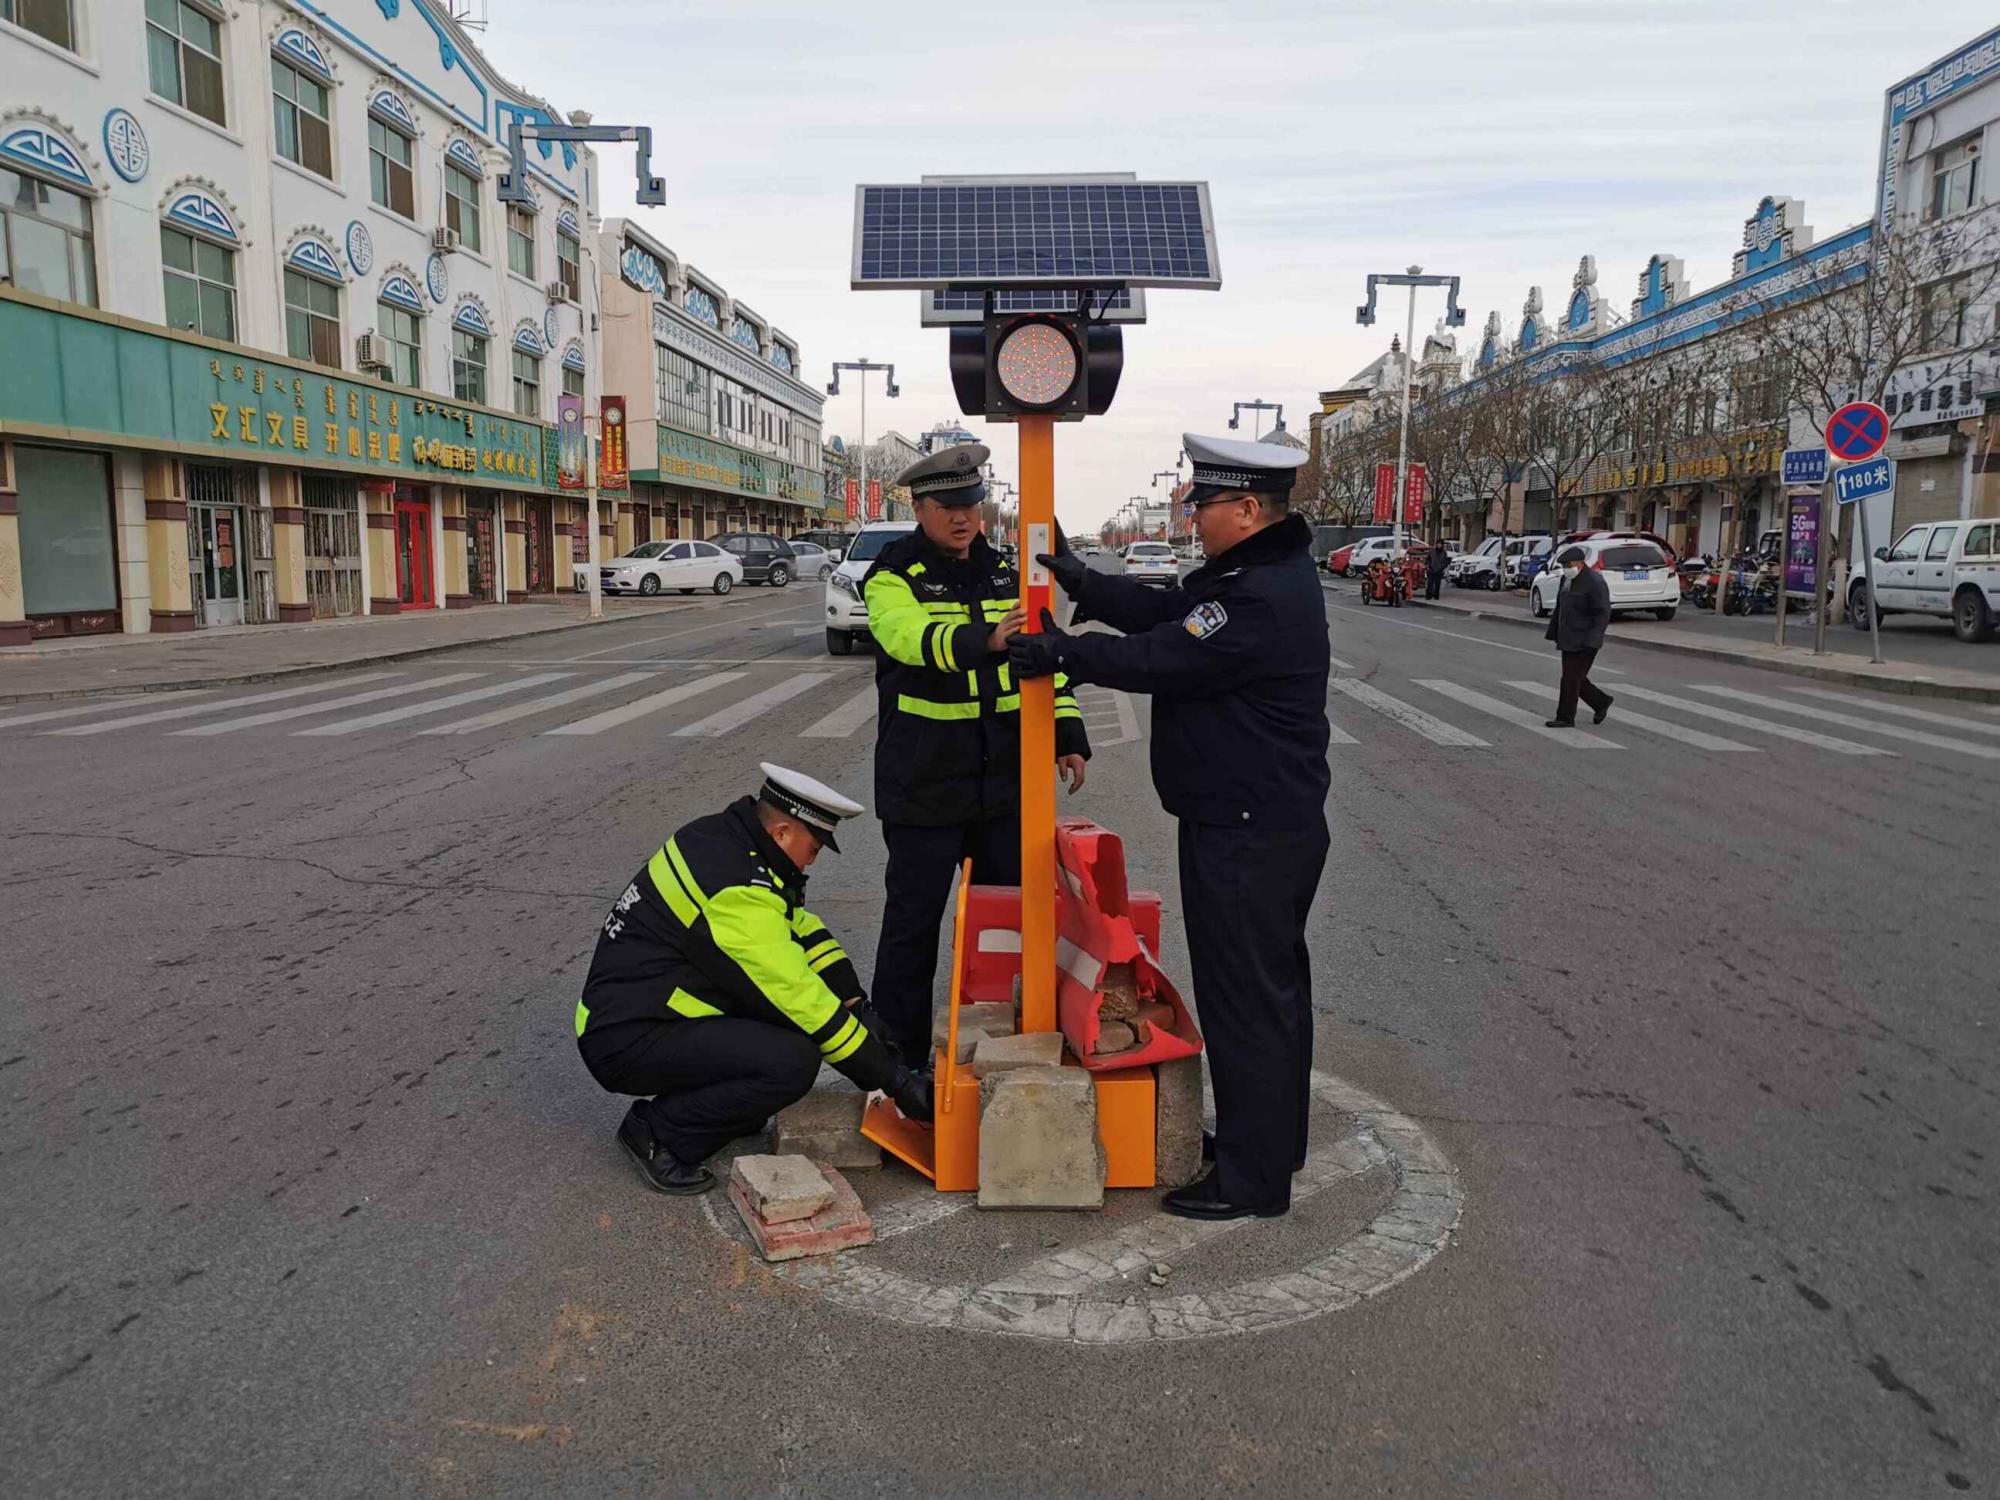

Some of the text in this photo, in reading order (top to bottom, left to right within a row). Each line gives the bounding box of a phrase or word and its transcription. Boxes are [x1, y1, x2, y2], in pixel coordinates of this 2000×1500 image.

[209, 401, 310, 451] 文汇文具
[1847, 465, 1889, 491] 180米
